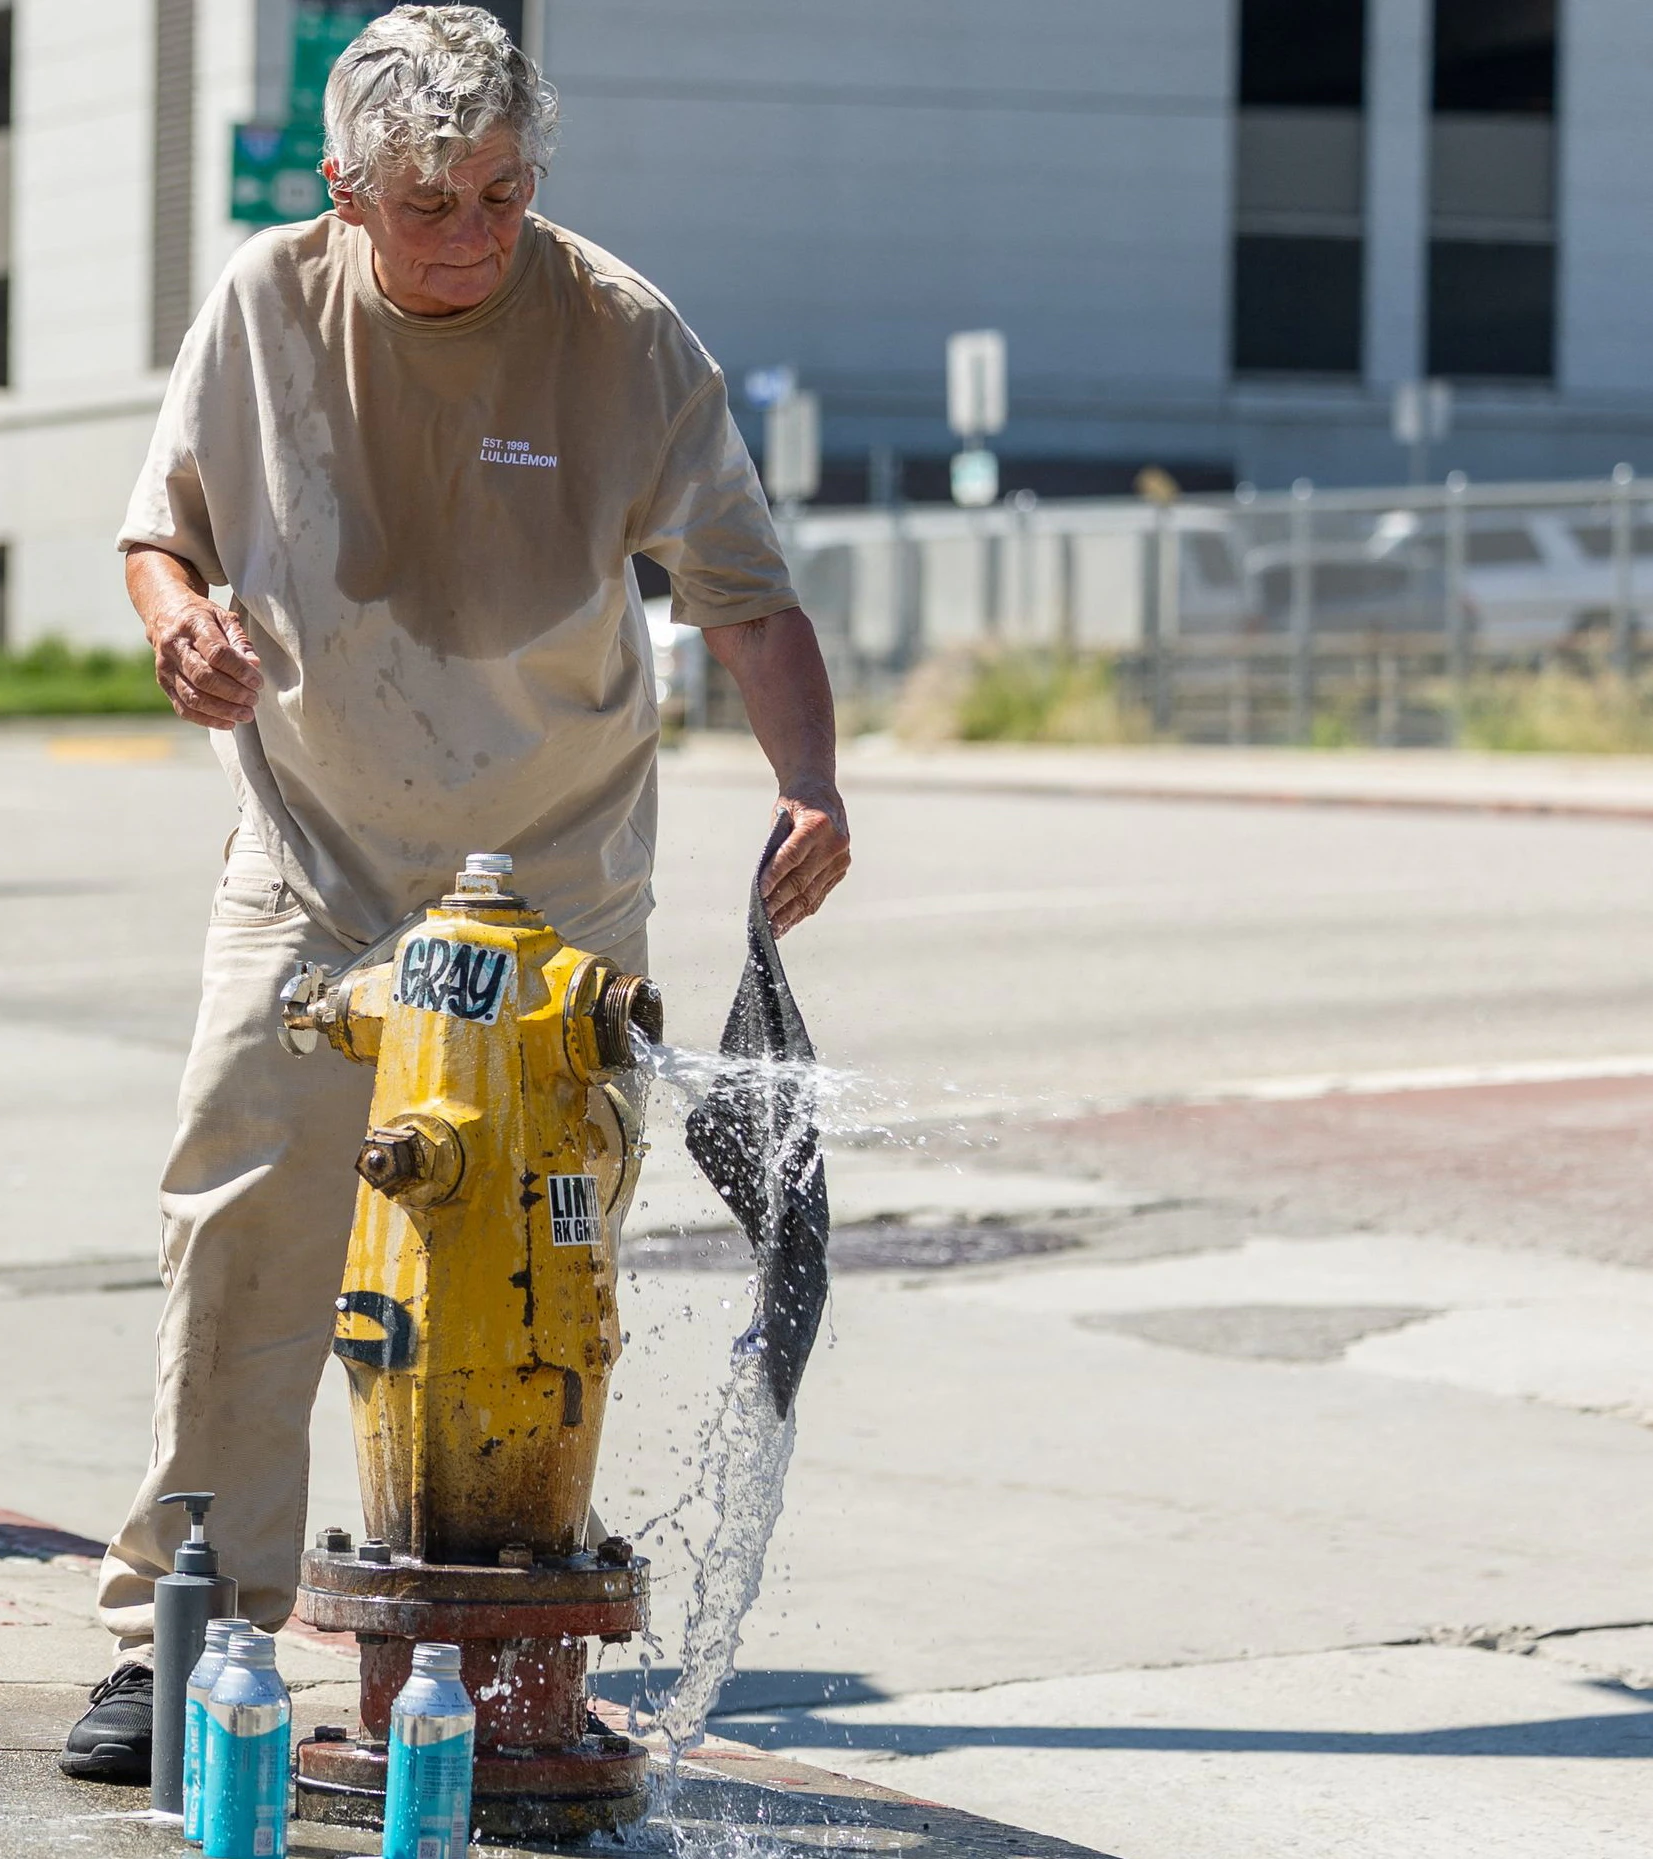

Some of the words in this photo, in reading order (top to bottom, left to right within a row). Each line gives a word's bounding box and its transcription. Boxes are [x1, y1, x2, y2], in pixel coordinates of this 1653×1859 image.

[482, 437, 504, 449] EST.
[506, 441, 530, 452] 1998
[479, 449, 558, 467] LULULEMON
